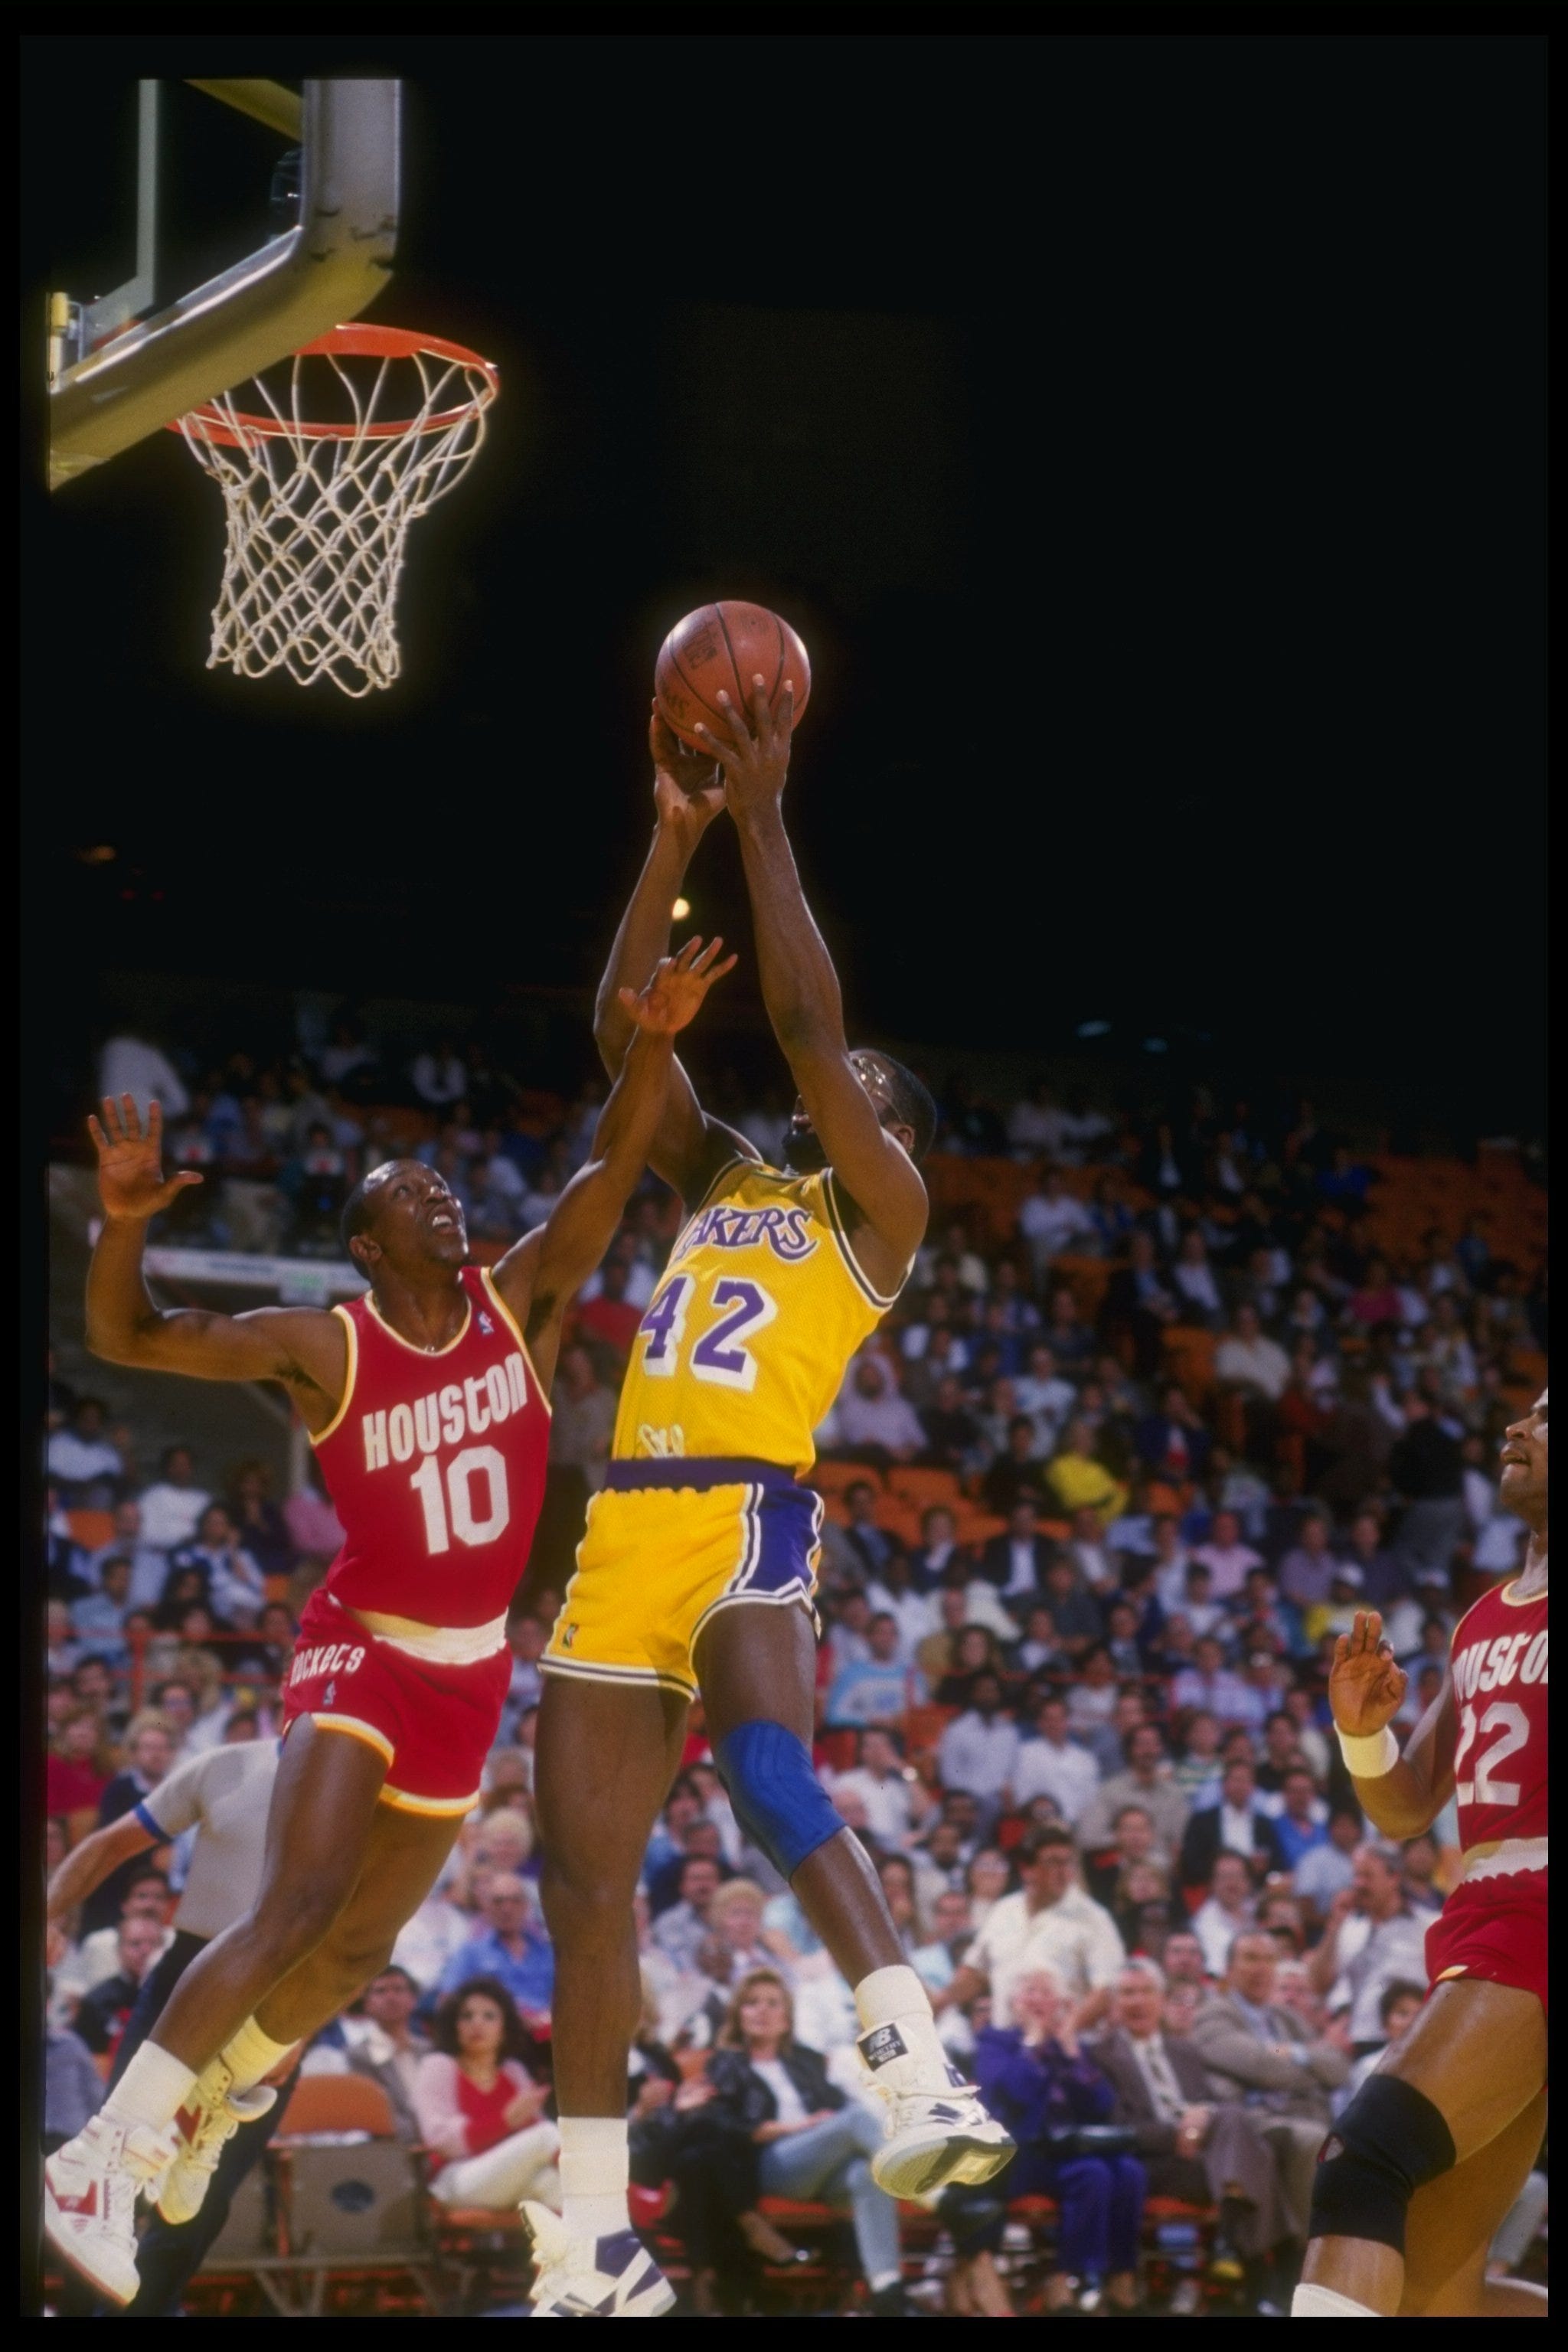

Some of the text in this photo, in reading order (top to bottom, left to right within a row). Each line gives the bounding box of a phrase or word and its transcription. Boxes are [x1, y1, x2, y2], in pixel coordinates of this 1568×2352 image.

[639, 1272, 779, 1393] 42
[410, 1444, 511, 1555] 10
[1452, 1628, 1548, 1701] OUSTO
[1454, 1701, 1530, 1807] 22
